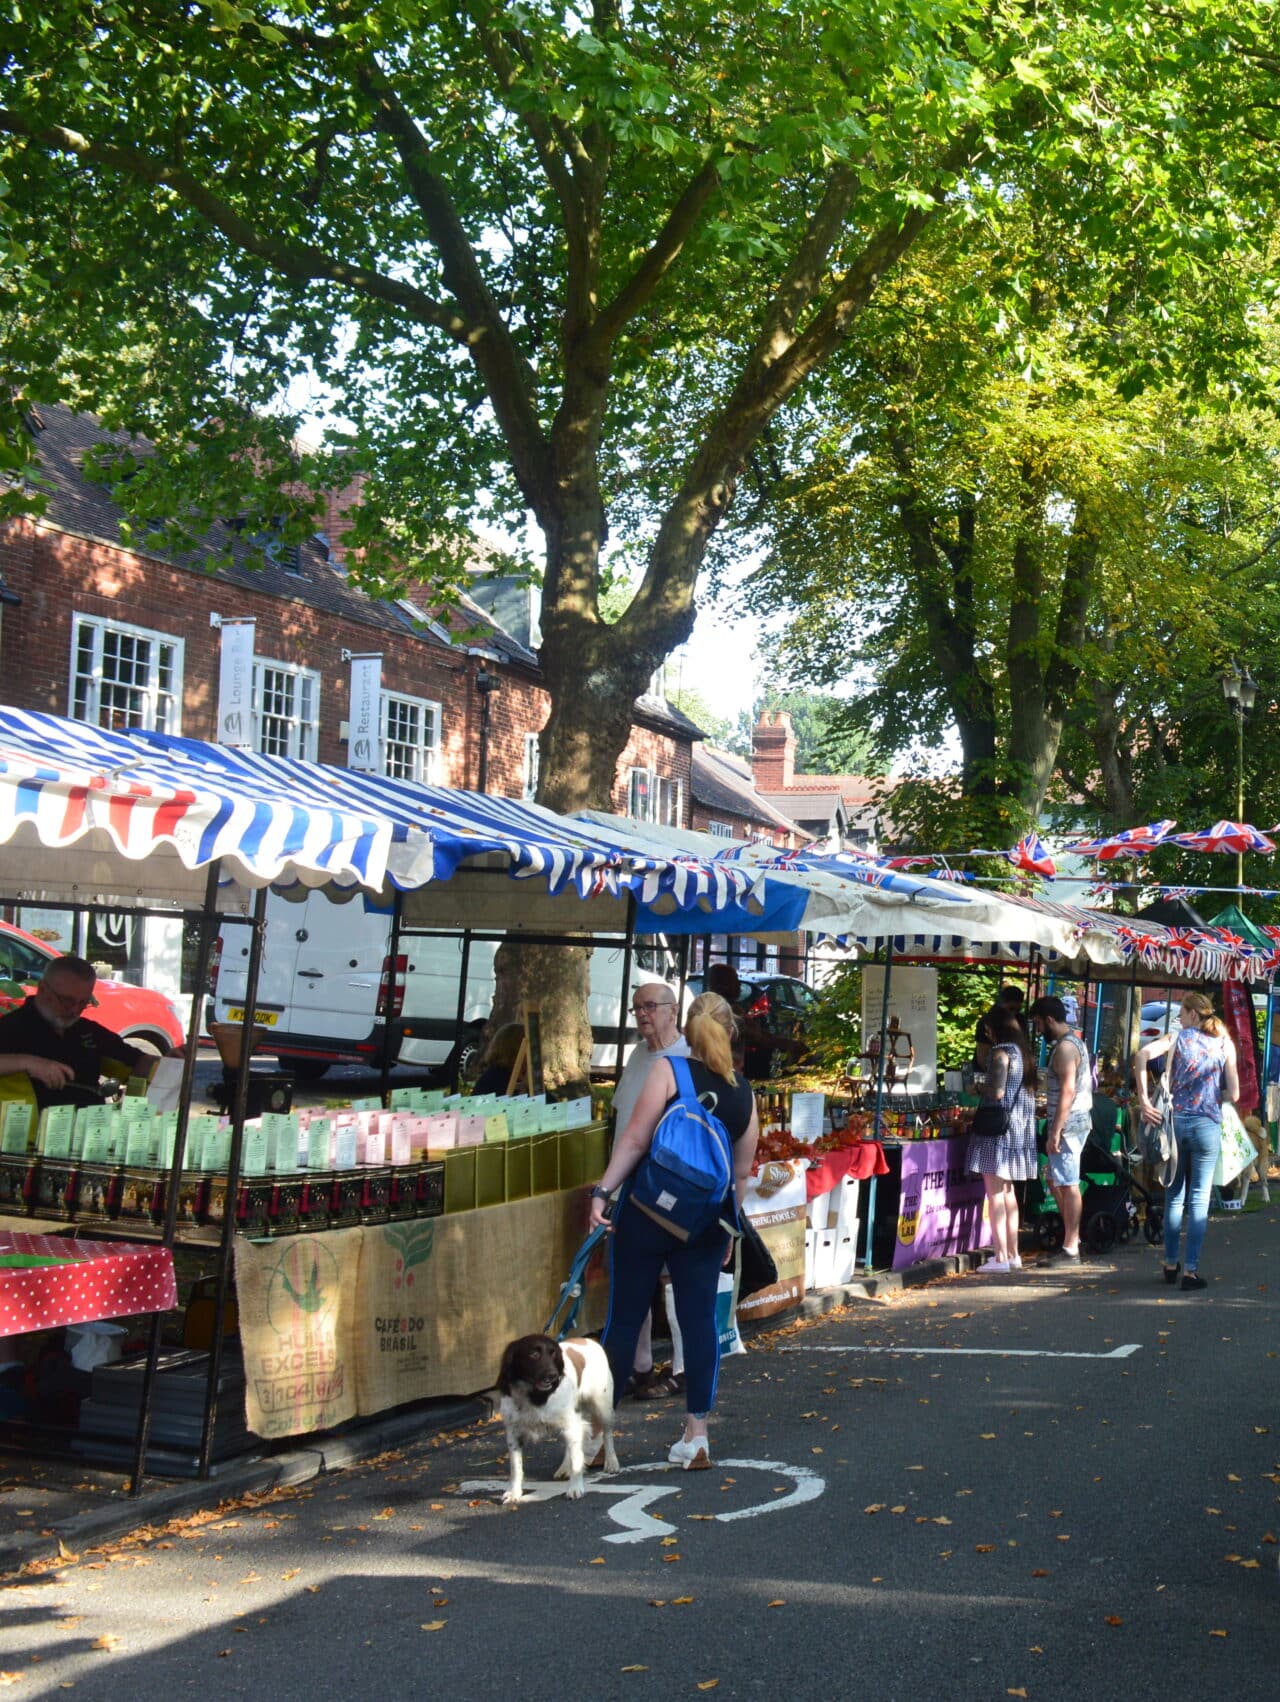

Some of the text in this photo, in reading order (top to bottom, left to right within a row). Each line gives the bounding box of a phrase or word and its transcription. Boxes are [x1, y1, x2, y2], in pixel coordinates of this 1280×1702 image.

[358, 663, 372, 734] Restaurant
[769, 1166, 791, 1185] Shop
[923, 1169, 945, 1191] THE
[904, 1195, 919, 1208] THE
[901, 1222, 916, 1238] LAB
[380, 1334, 417, 1352] BRASIL
